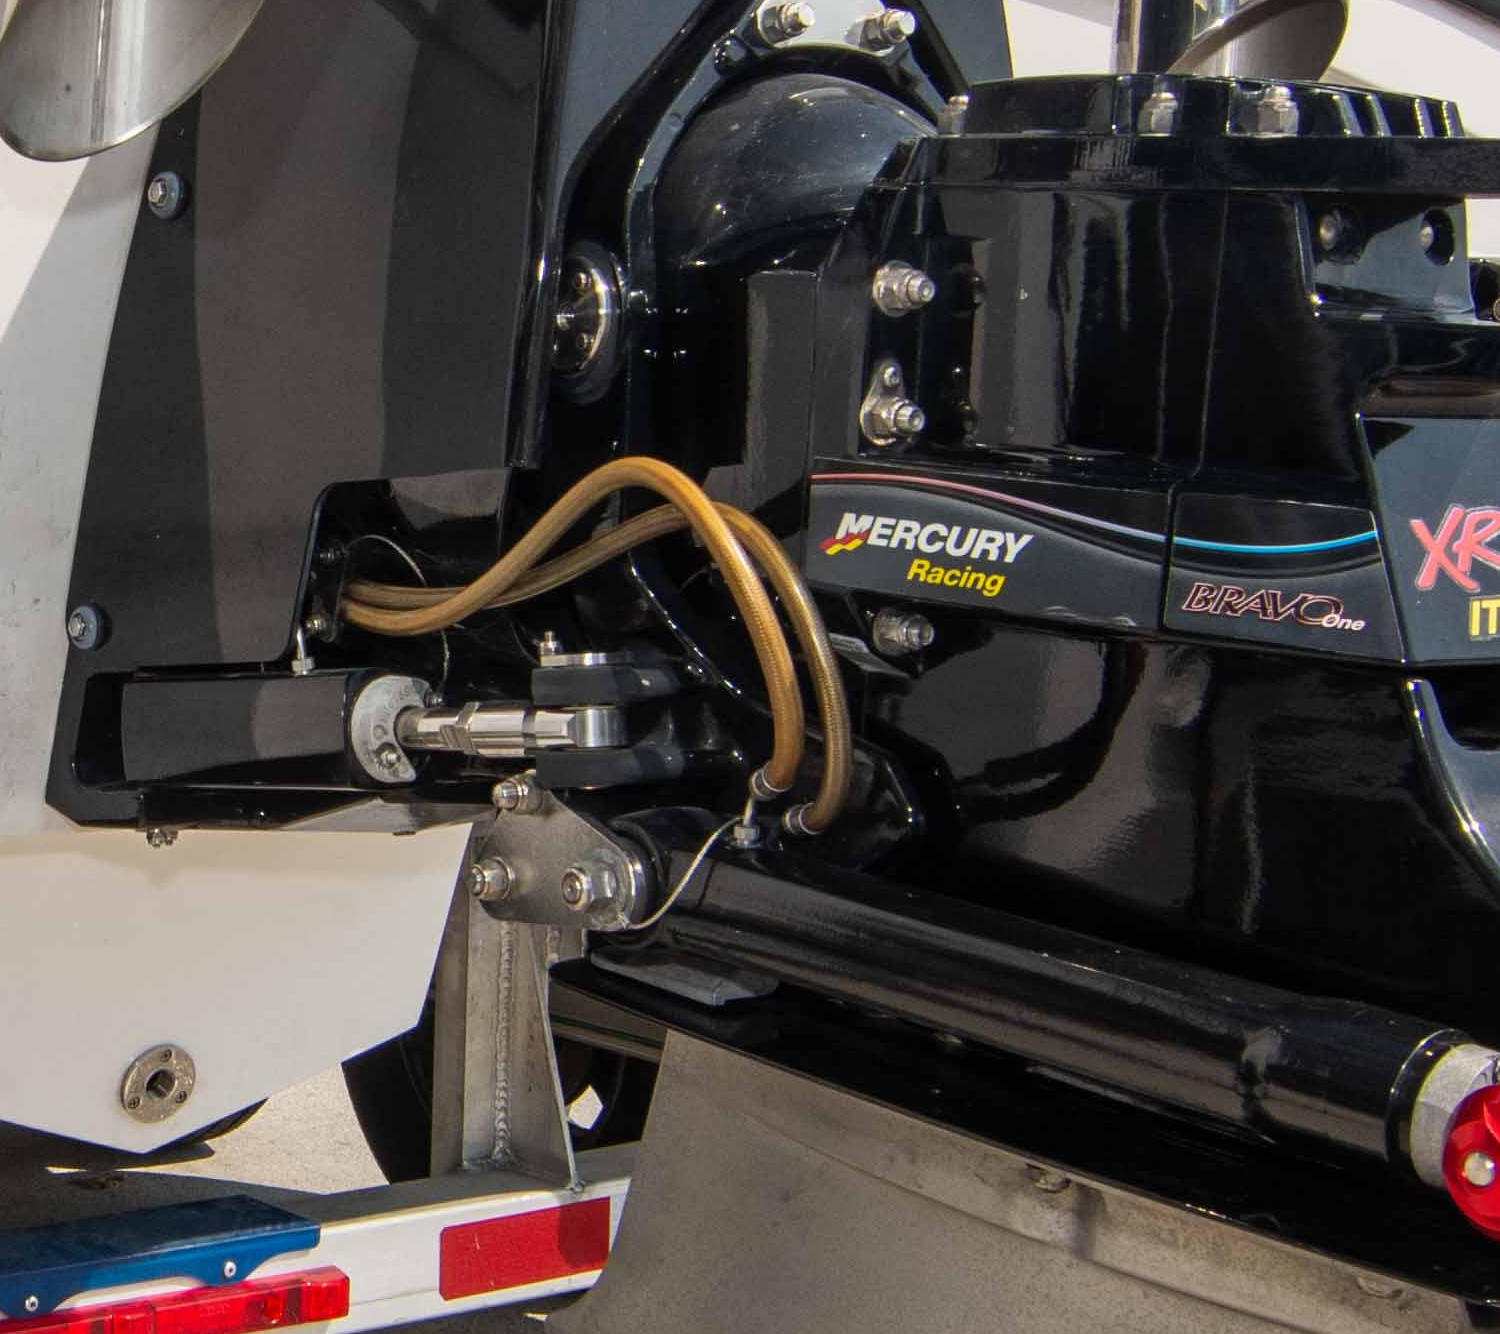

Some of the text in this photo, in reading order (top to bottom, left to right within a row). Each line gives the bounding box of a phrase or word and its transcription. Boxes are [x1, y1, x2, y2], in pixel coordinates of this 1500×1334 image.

[834, 512, 1035, 564] MERCURY
[906, 557, 1006, 598] Racing
[1181, 582, 1366, 631] BRAVO One
